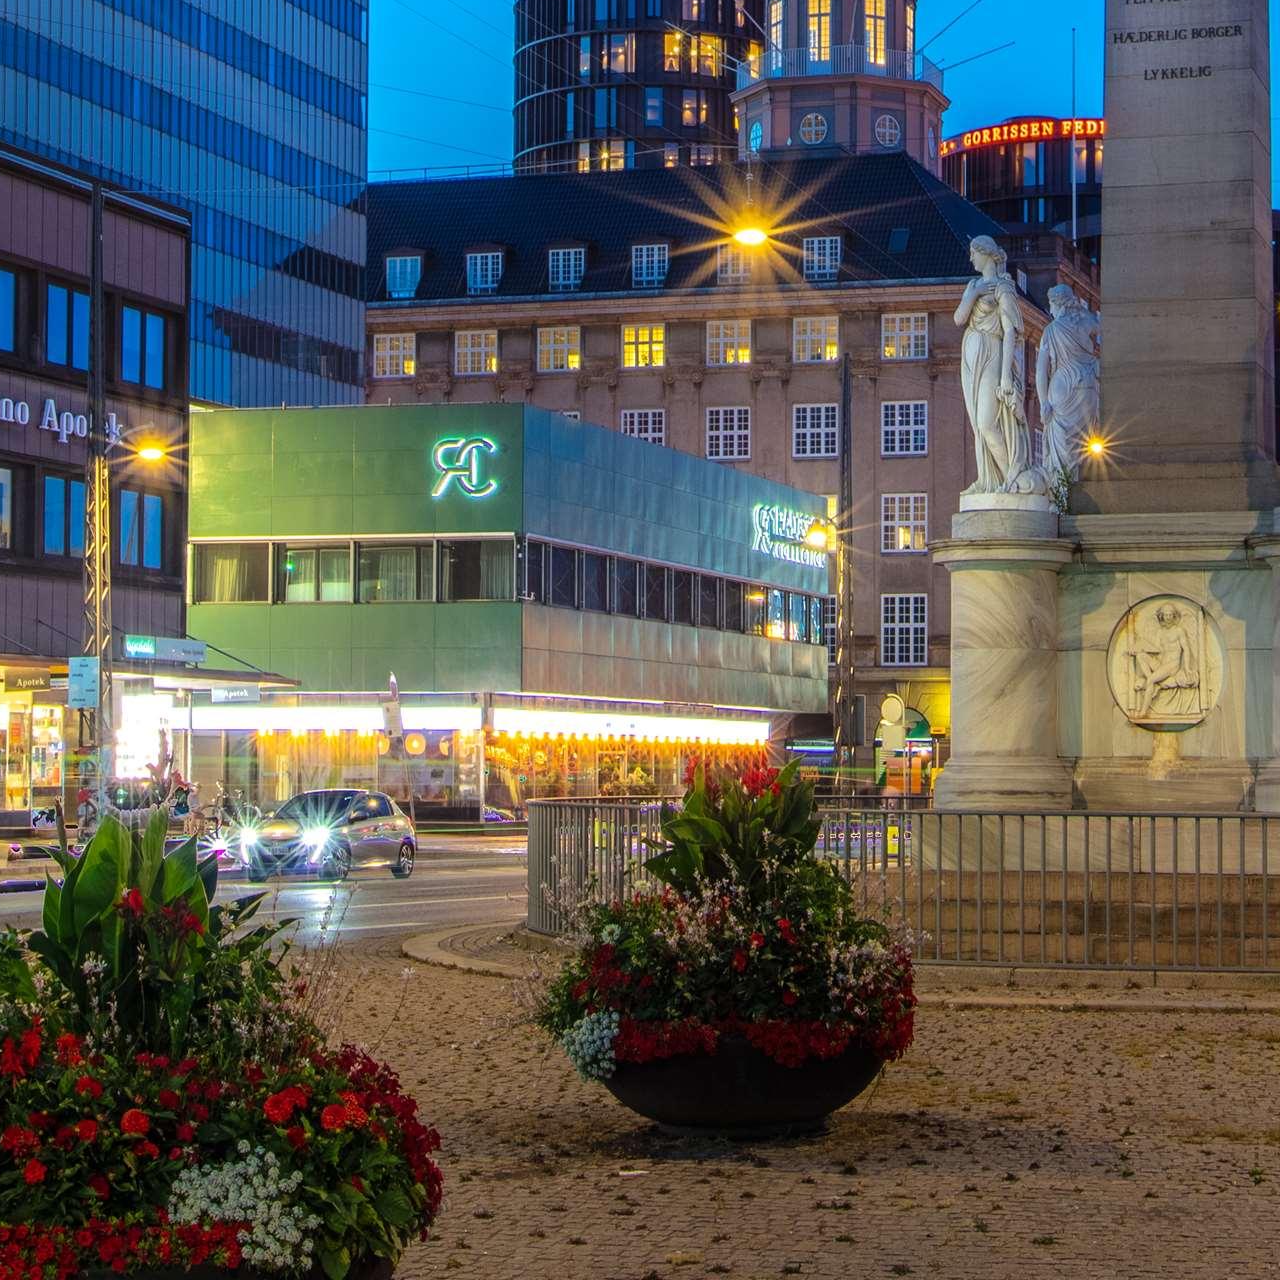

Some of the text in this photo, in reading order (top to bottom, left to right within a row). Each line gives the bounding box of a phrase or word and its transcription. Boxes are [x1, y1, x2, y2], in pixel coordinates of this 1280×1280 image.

[1114, 24, 1243, 44] HÆDERLIG BORGER
[1144, 65, 1212, 81] LYKKELIG
[963, 121, 1054, 147] GORRISSEN
[39, 398, 123, 445] Apok
[16, 677, 45, 689] Apotek
[223, 689, 249, 700] Apotek
